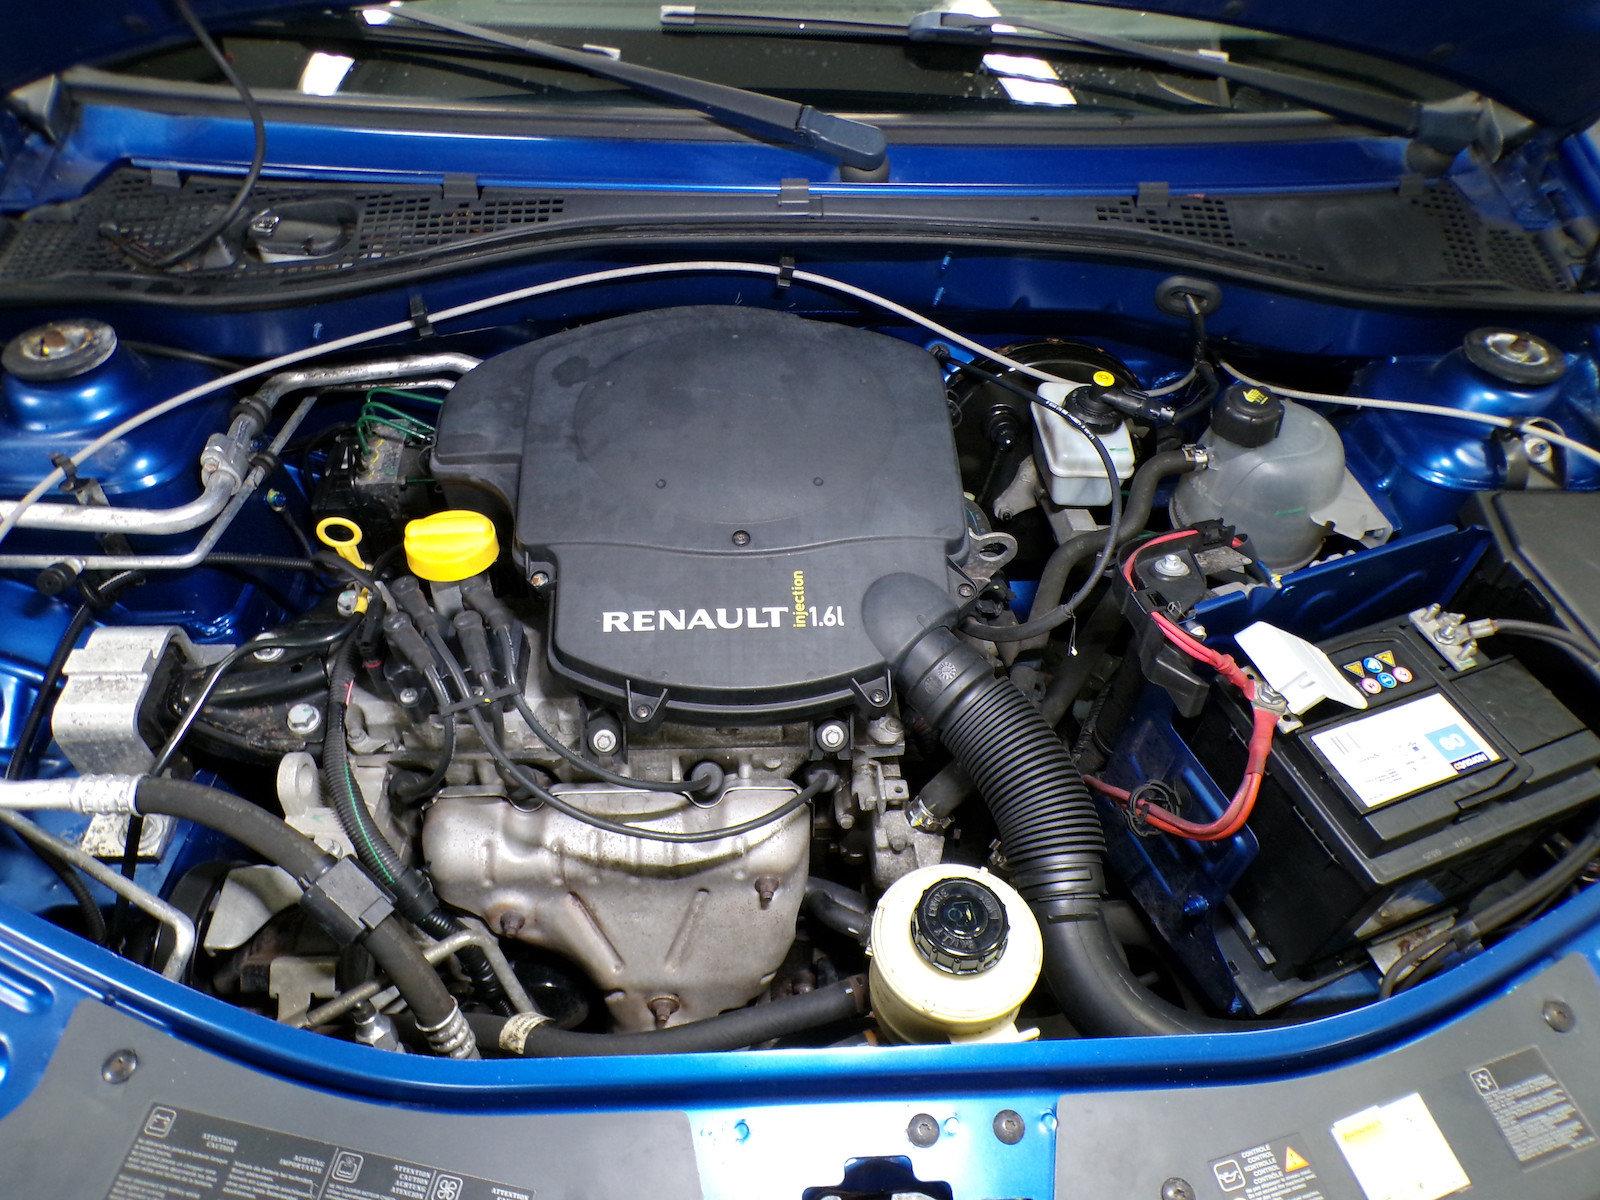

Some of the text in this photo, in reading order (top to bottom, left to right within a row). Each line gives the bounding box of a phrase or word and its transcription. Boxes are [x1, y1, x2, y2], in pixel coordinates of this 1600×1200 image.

[791, 570, 809, 628] injection
[602, 606, 789, 632] RENAULT
[392, 1164, 431, 1179] ATTENTION
[398, 1173, 429, 1186] CAUTION
[490, 1187, 530, 1200] ATTENTION
